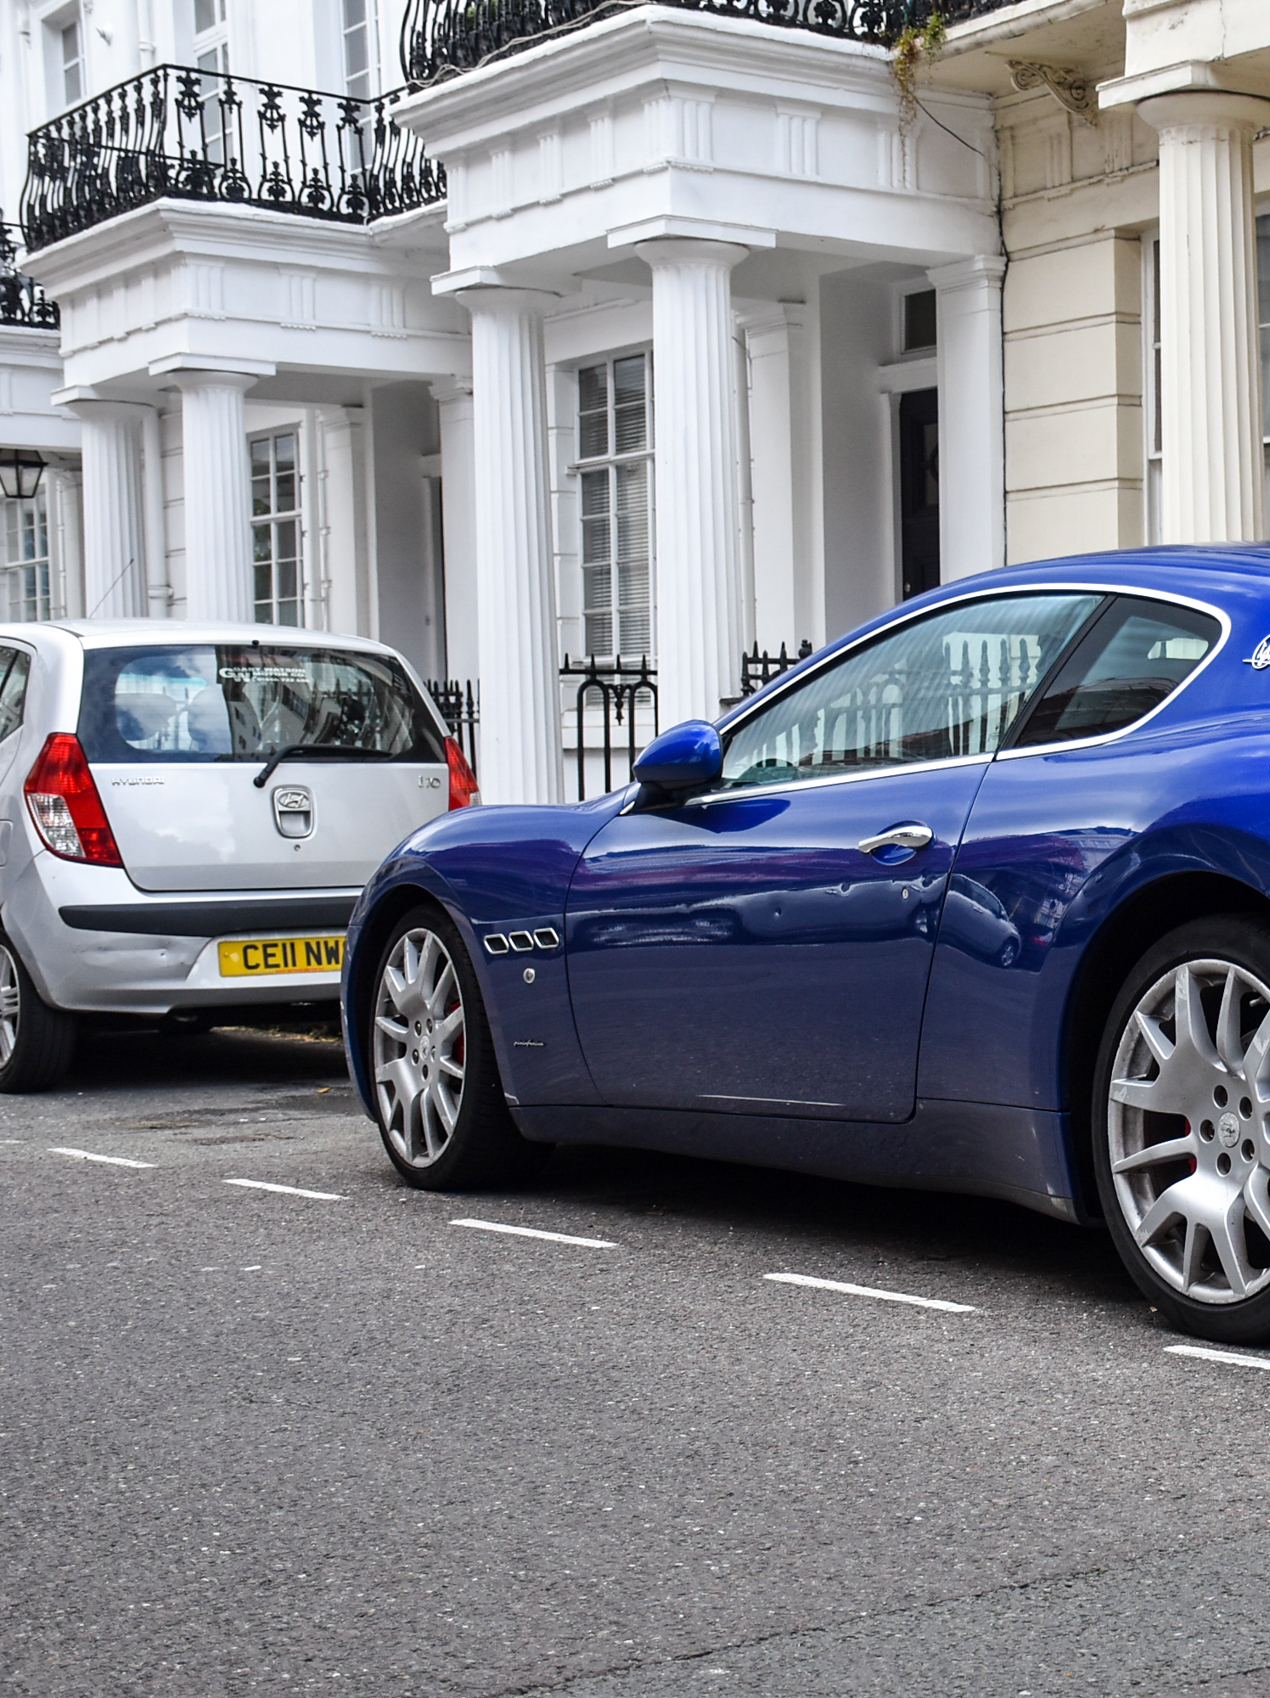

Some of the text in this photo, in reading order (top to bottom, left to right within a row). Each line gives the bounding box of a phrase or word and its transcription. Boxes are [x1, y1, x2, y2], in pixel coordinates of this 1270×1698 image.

[111, 777, 165, 786] HYUNDAI
[418, 775, 441, 788] i10
[243, 940, 345, 970] CE11 NW
